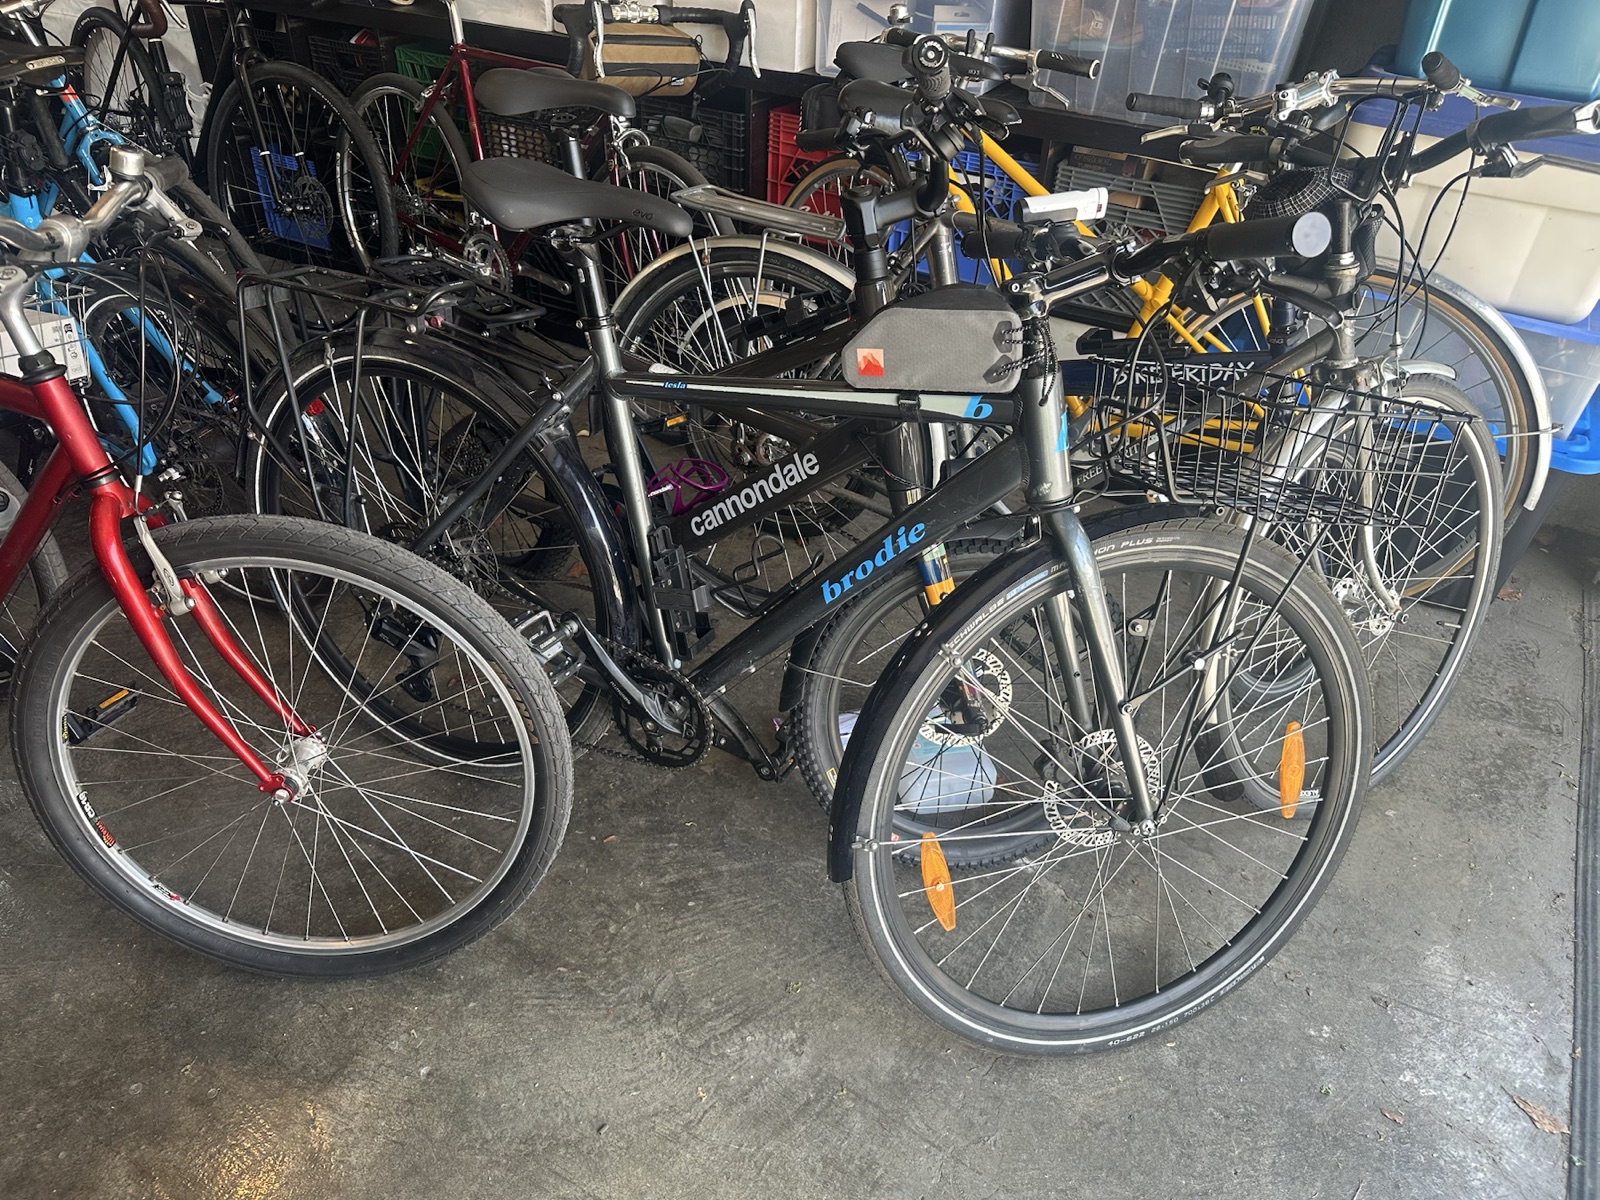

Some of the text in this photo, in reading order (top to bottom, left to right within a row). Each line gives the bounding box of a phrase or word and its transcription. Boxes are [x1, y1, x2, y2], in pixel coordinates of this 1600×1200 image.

[631, 209, 654, 221] evo
[1112, 361, 1255, 385] BKE FRIDAY
[664, 381, 686, 389] tesla
[1076, 465, 1103, 486] FREE
[690, 452, 821, 536] cannondale
[821, 522, 926, 604] brodie
[946, 597, 1005, 649] SCHWALBE
[1120, 537, 1154, 549] PLUS
[1107, 1031, 1145, 1047] 40-622
